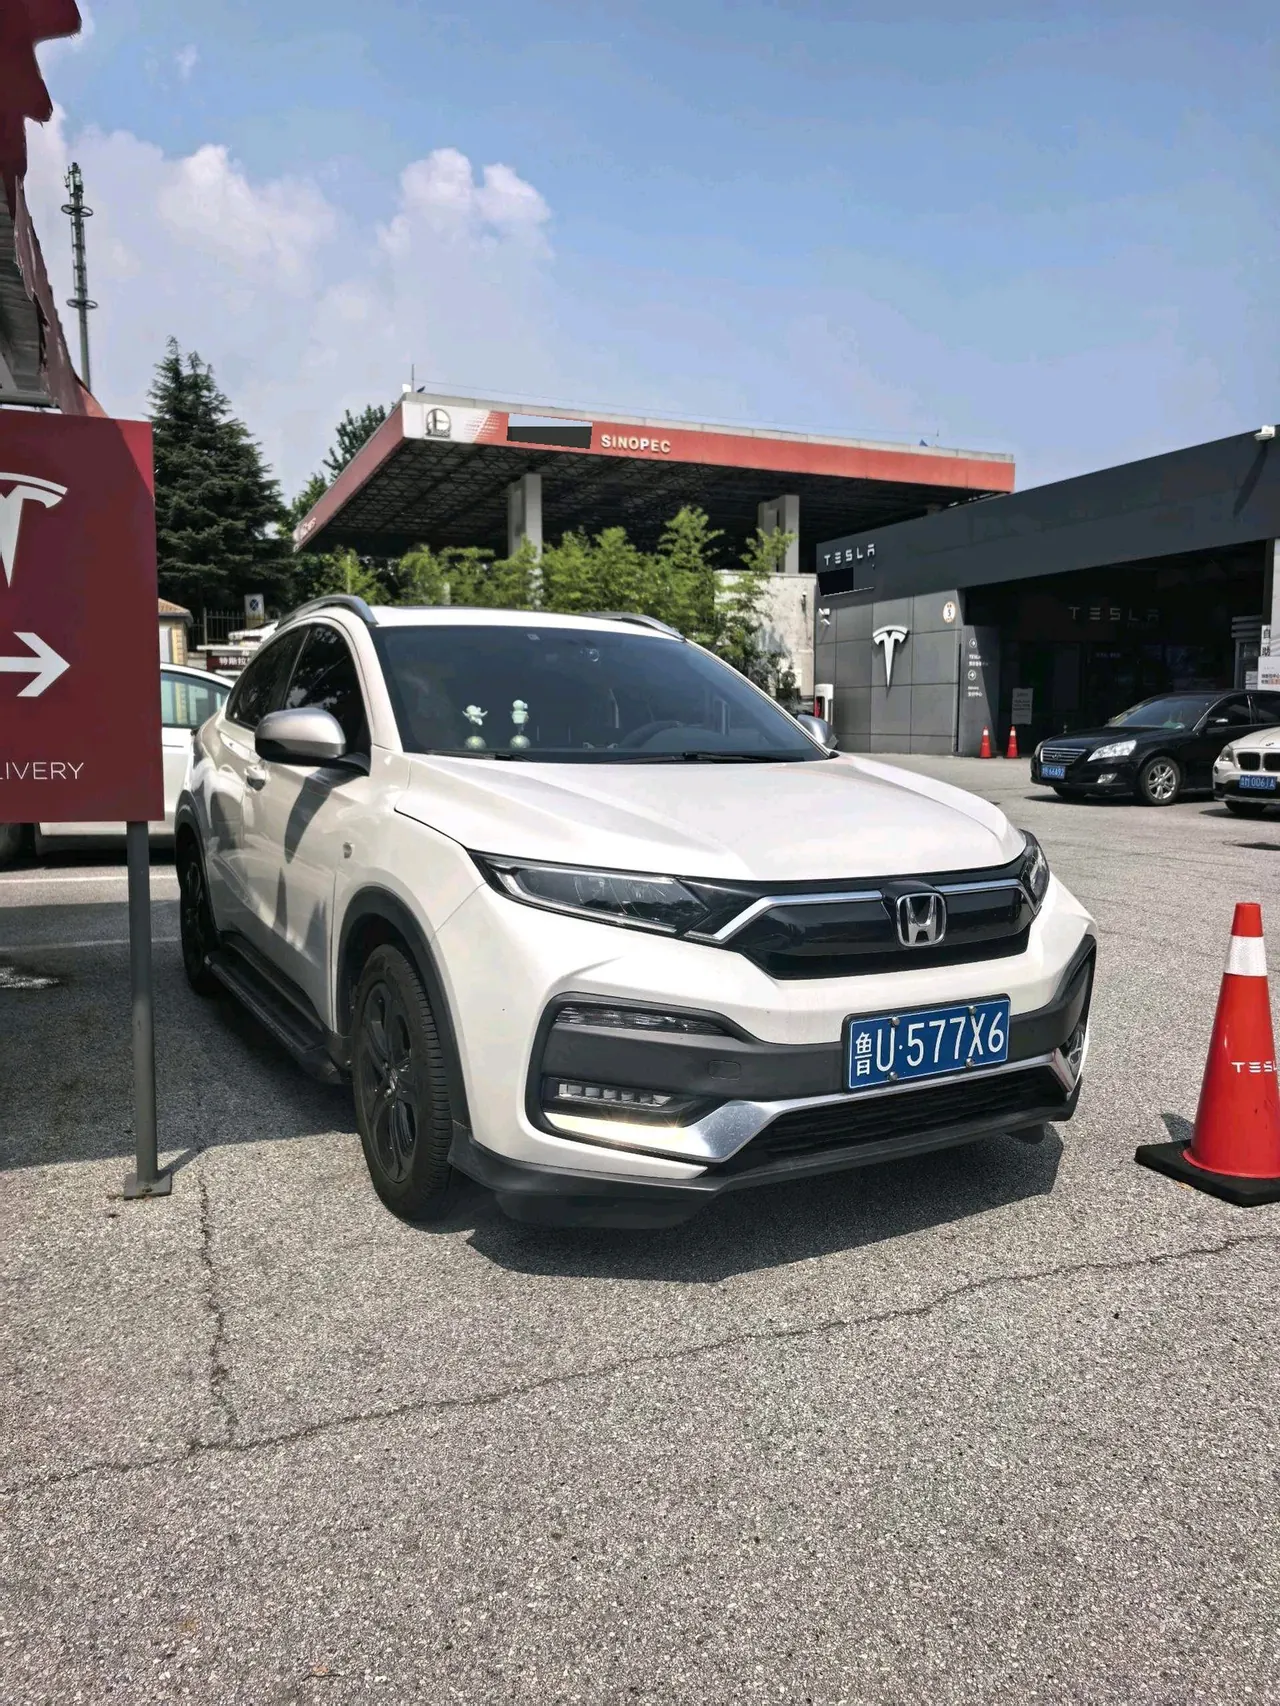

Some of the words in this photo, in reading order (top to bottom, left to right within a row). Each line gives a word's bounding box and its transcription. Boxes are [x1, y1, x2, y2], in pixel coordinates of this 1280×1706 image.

[601, 434, 671, 453] SINOPEC
[824, 543, 875, 566] TESLA
[1068, 606, 1159, 622] TESLA
[855, 1011, 1005, 1077] 鲁U·577X6
